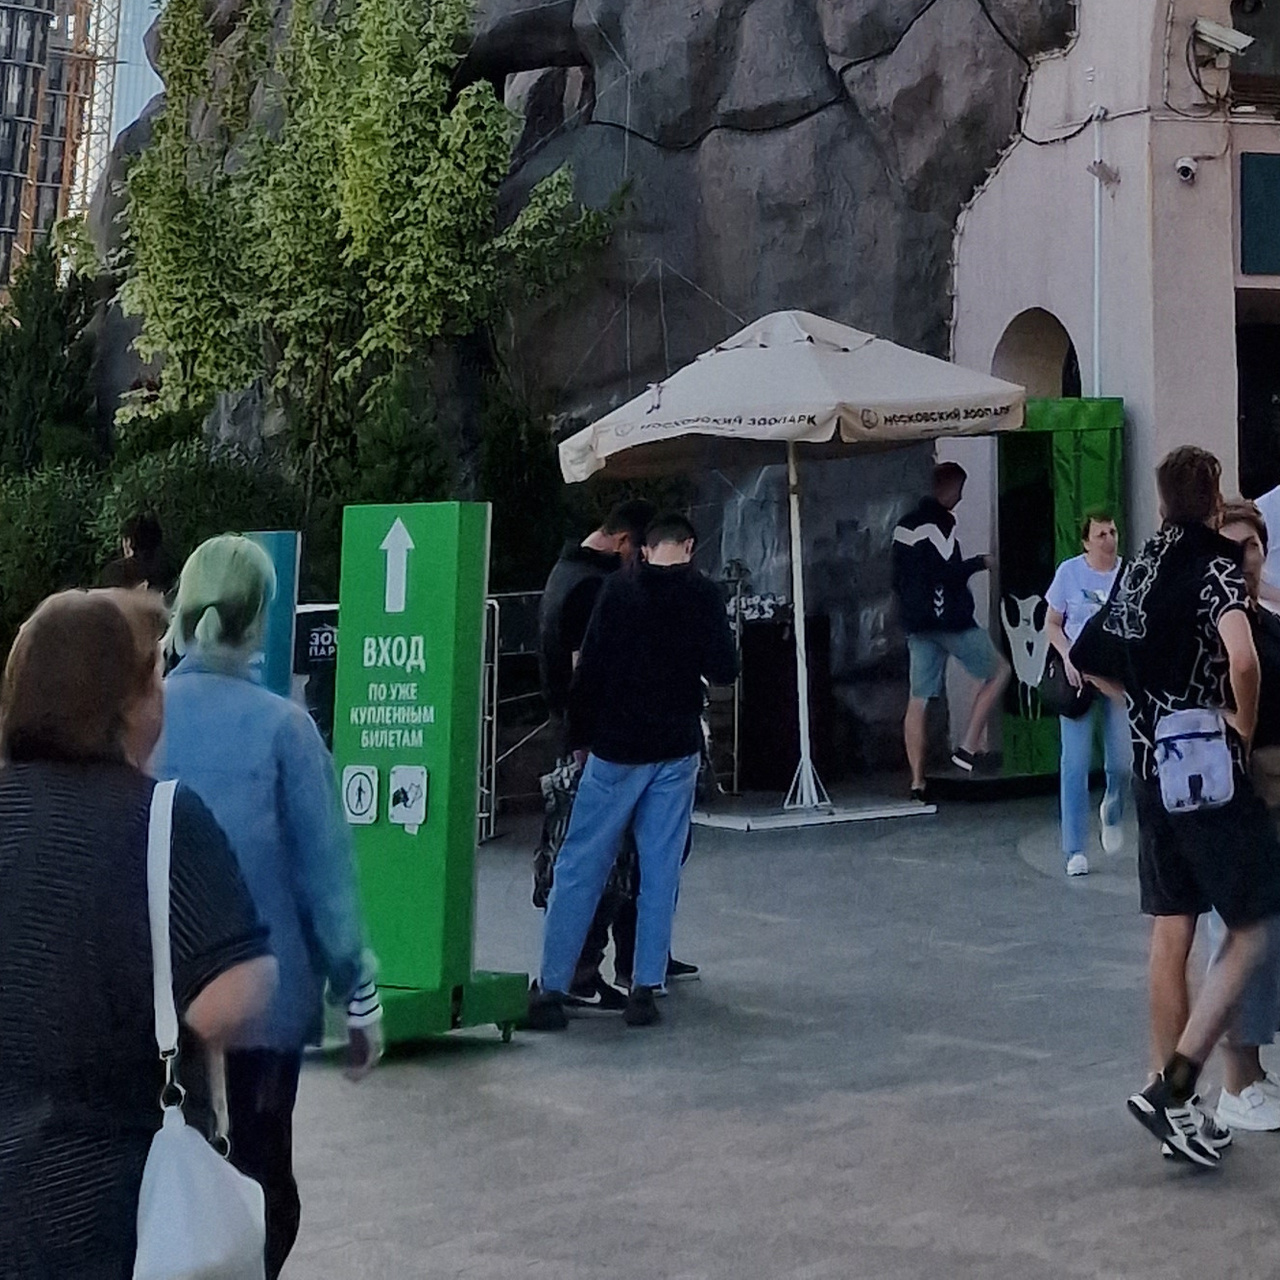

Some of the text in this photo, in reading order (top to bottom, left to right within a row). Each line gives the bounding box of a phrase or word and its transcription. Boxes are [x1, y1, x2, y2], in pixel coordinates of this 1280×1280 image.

[362, 635, 426, 673] ВХОД
[368, 683, 418, 701] ПО УЖЕ
[350, 706, 434, 725] КУПЛЕННЫМ
[361, 729, 424, 748] БИЛЕТАМ
